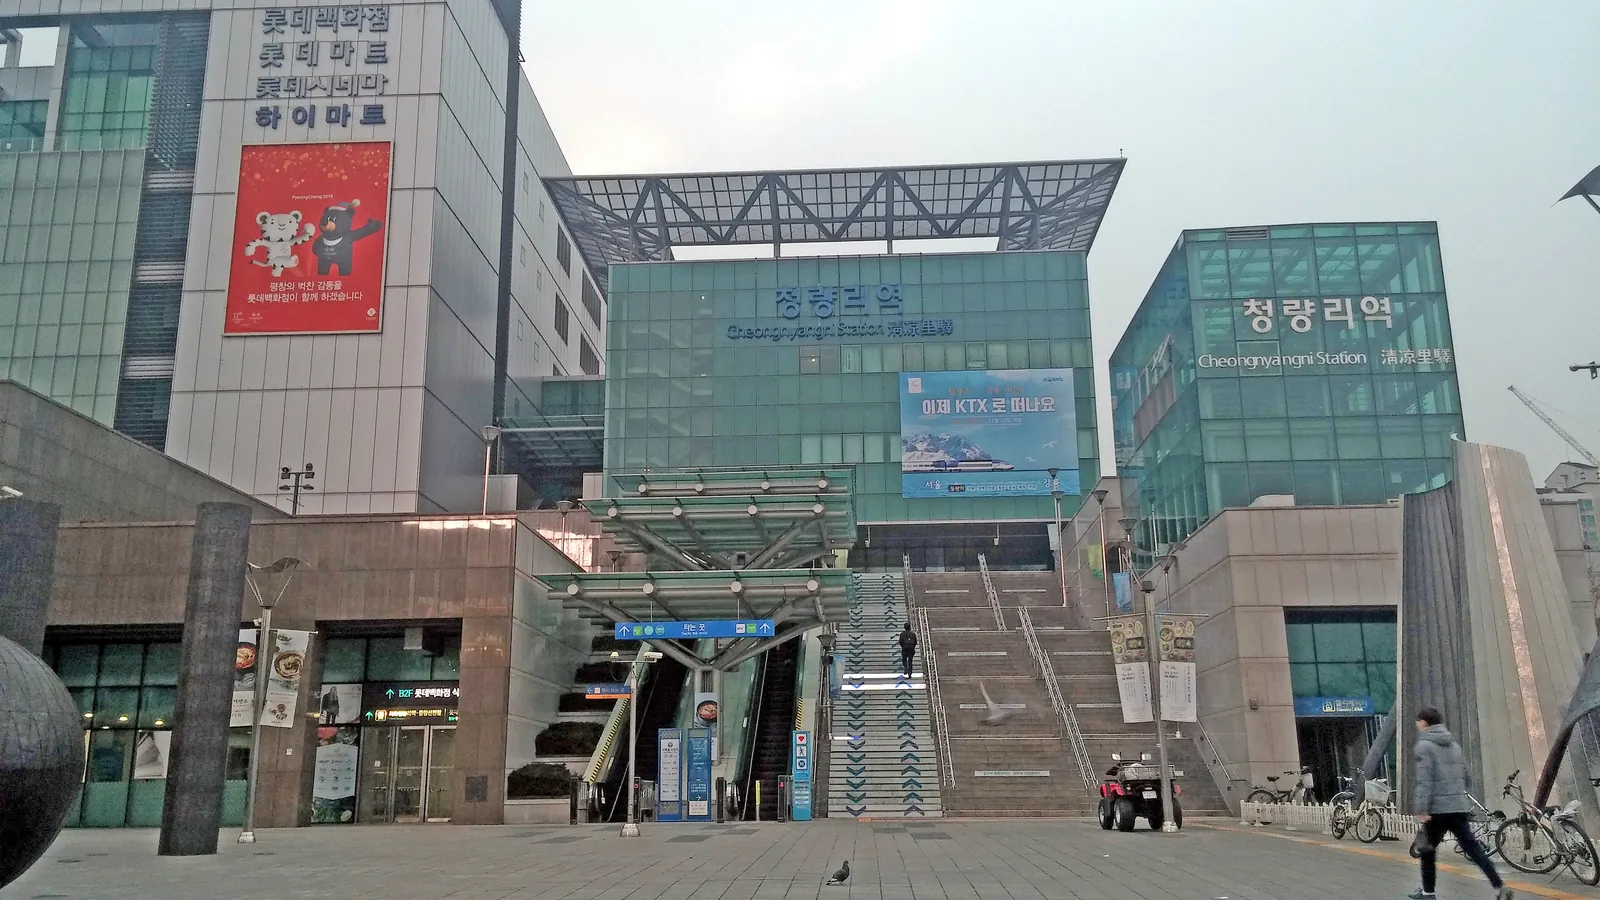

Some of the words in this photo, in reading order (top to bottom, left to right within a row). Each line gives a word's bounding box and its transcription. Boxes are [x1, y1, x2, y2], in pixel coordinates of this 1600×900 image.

[262, 5, 389, 34] 롯데백화점
[259, 41, 388, 68] 롯데마트
[256, 74, 388, 98] 롯데시네마
[256, 103, 386, 129] 하이마트
[269, 281, 295, 292] 평창의
[297, 281, 315, 291] 벅찬
[317, 280, 342, 290] 감동을
[247, 292, 298, 304] 롯데백화점이
[301, 292, 318, 302] 함께
[320, 291, 363, 302] 하겠습니다
[776, 283, 903, 319] 청량리역
[1243, 296, 1393, 333] 청량리역
[727, 324, 835, 341] Cheongnyangni
[838, 322, 885, 337] Station
[1198, 351, 1314, 369] Cheongnyangni
[1316, 350, 1367, 365] Station
[922, 399, 951, 415] 이제
[955, 398, 988, 414] KTX
[991, 397, 1007, 413] 로
[1011, 396, 1056, 412] 떠나요
[924, 479, 943, 490] 서울
[683, 624, 696, 632] 타는
[698, 623, 705, 631] 곳
[398, 689, 414, 697] B2F
[414, 688, 451, 698] 롯데백화점
